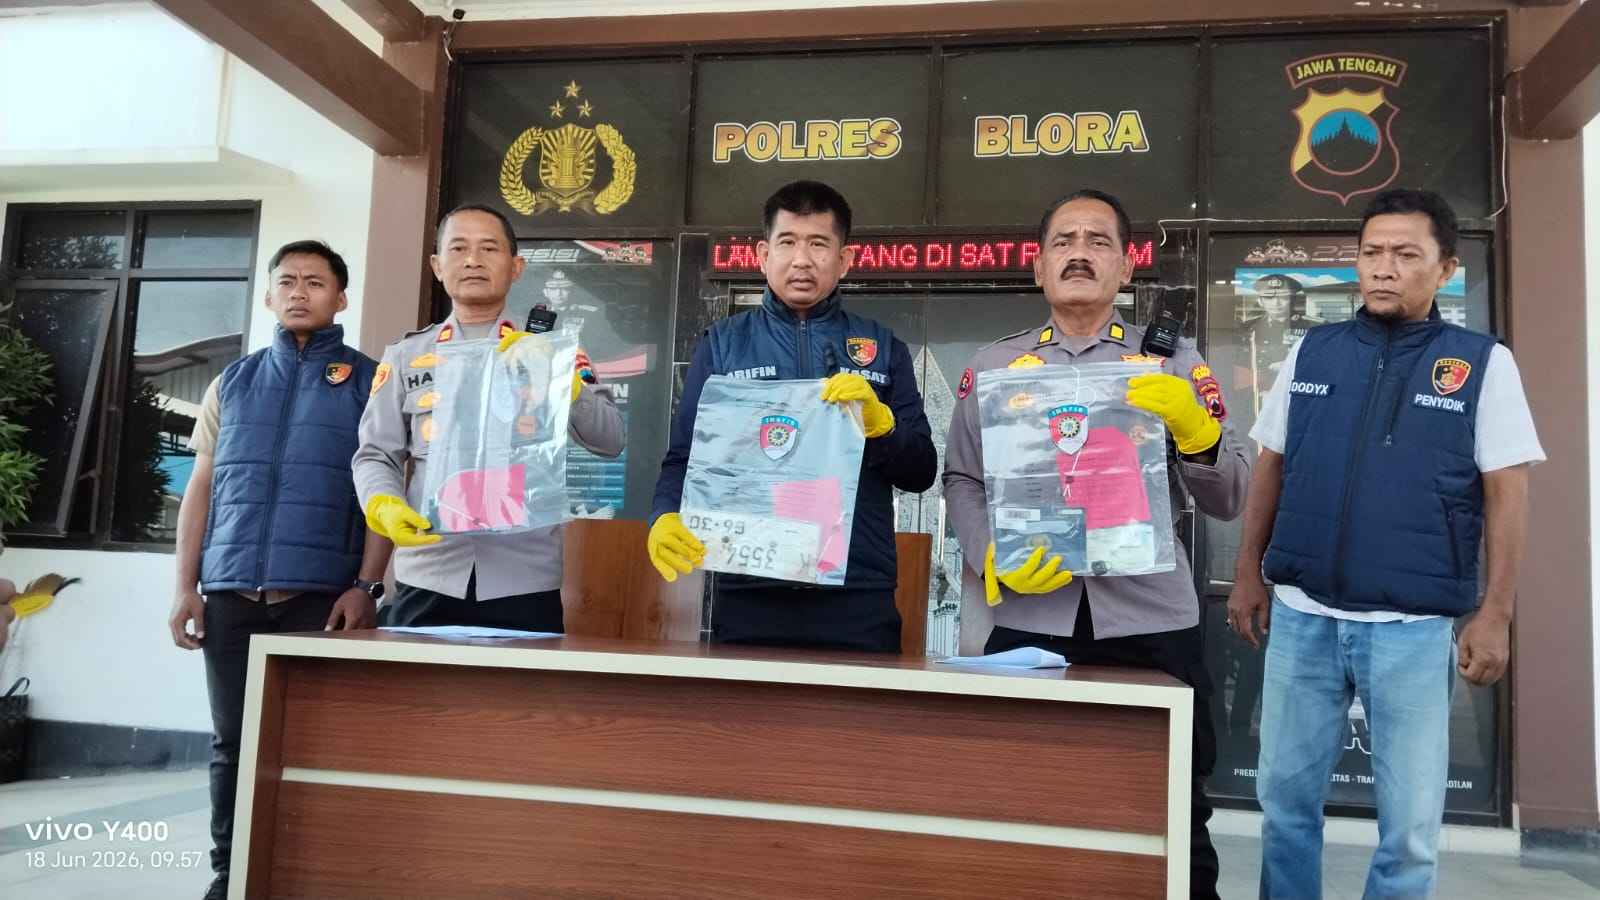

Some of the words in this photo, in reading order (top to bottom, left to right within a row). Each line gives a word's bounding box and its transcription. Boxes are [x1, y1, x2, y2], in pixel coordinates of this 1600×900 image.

[1296, 58, 1335, 79] JAWA
[1338, 57, 1397, 77] TENGAH
[713, 117, 902, 163] POLRES
[974, 110, 1150, 158] BLORA
[847, 243, 919, 268] TANG
[926, 243, 953, 268] DI
[959, 242, 1014, 267] SAT
[1414, 394, 1466, 413] PENYIDIK
